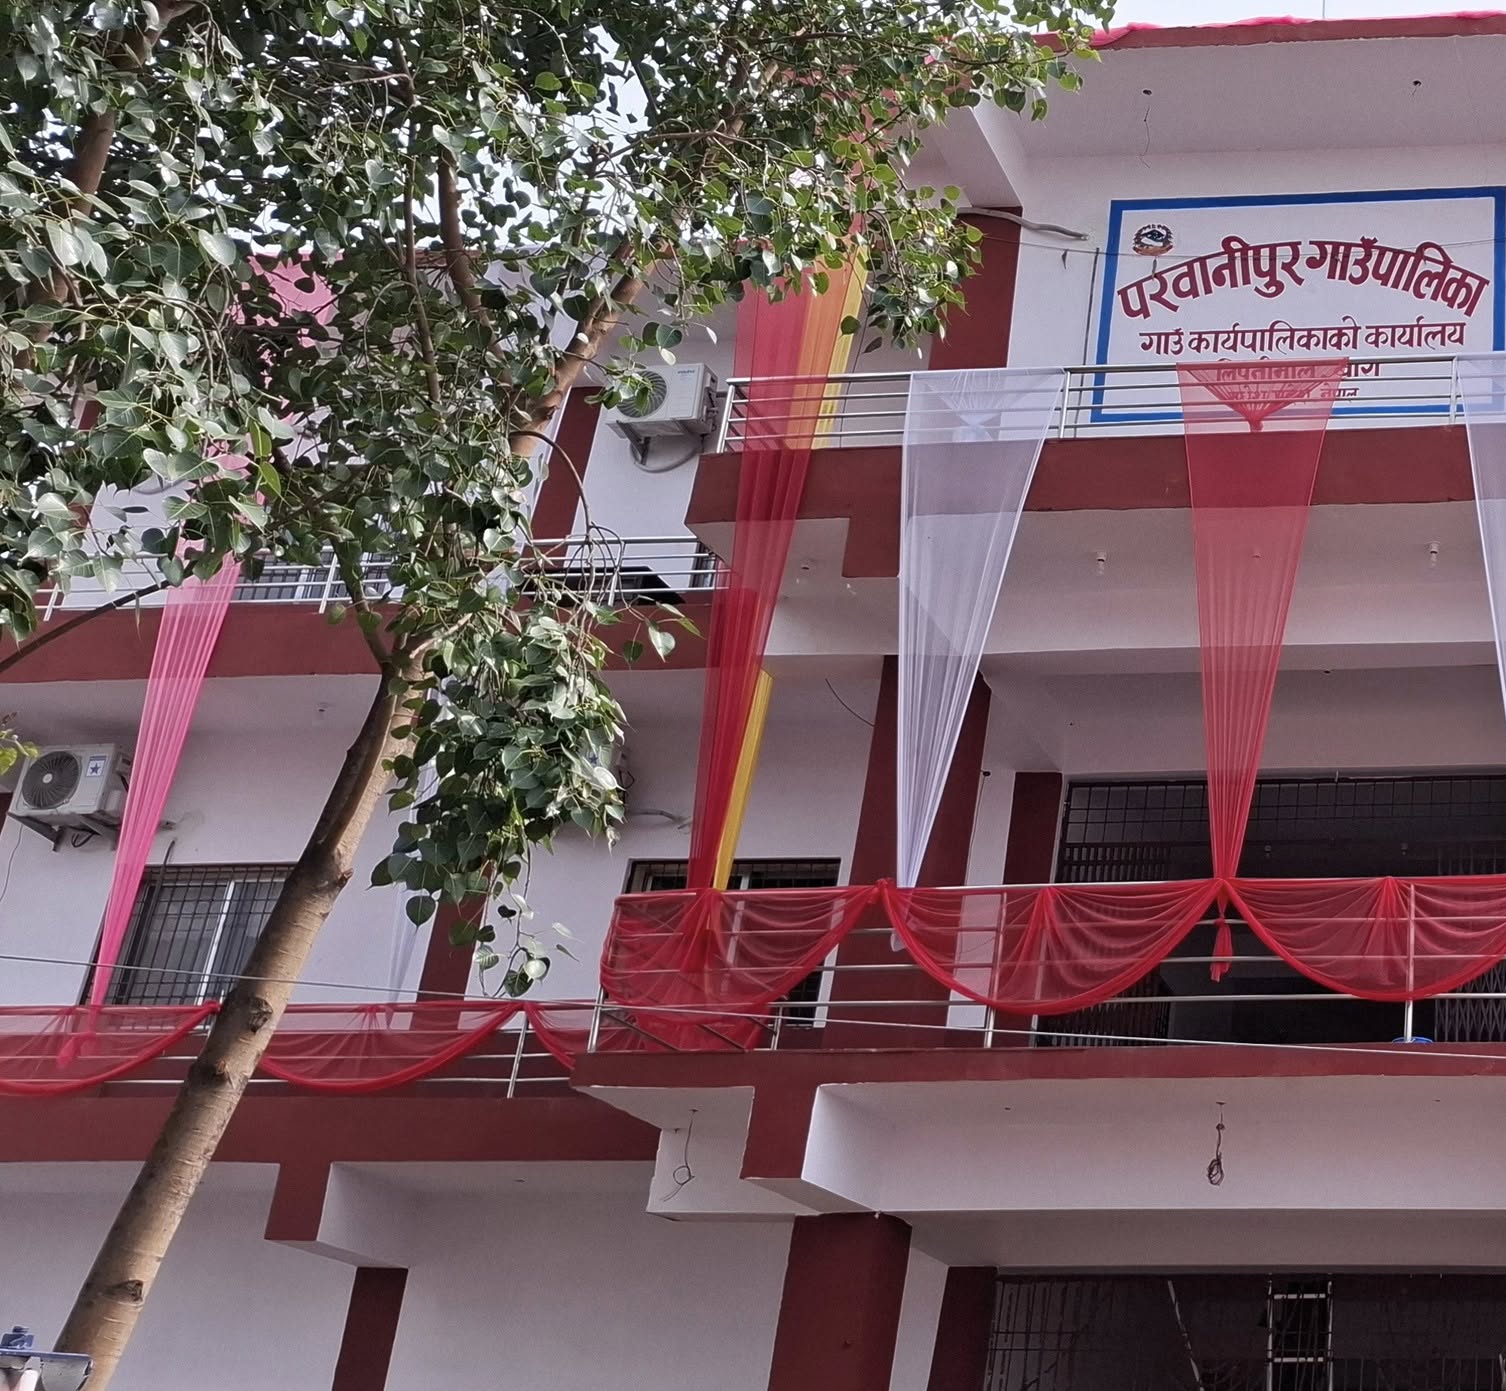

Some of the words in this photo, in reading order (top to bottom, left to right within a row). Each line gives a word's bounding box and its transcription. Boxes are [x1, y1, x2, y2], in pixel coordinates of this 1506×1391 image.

[1117, 236, 1304, 319] परवानीपुर
[1306, 236, 1490, 317] गाउँपालिका
[1139, 328, 1184, 355] गाउँ
[1188, 315, 1361, 355] कार्यपालिकाको
[1365, 315, 1466, 350] कार्यालय
